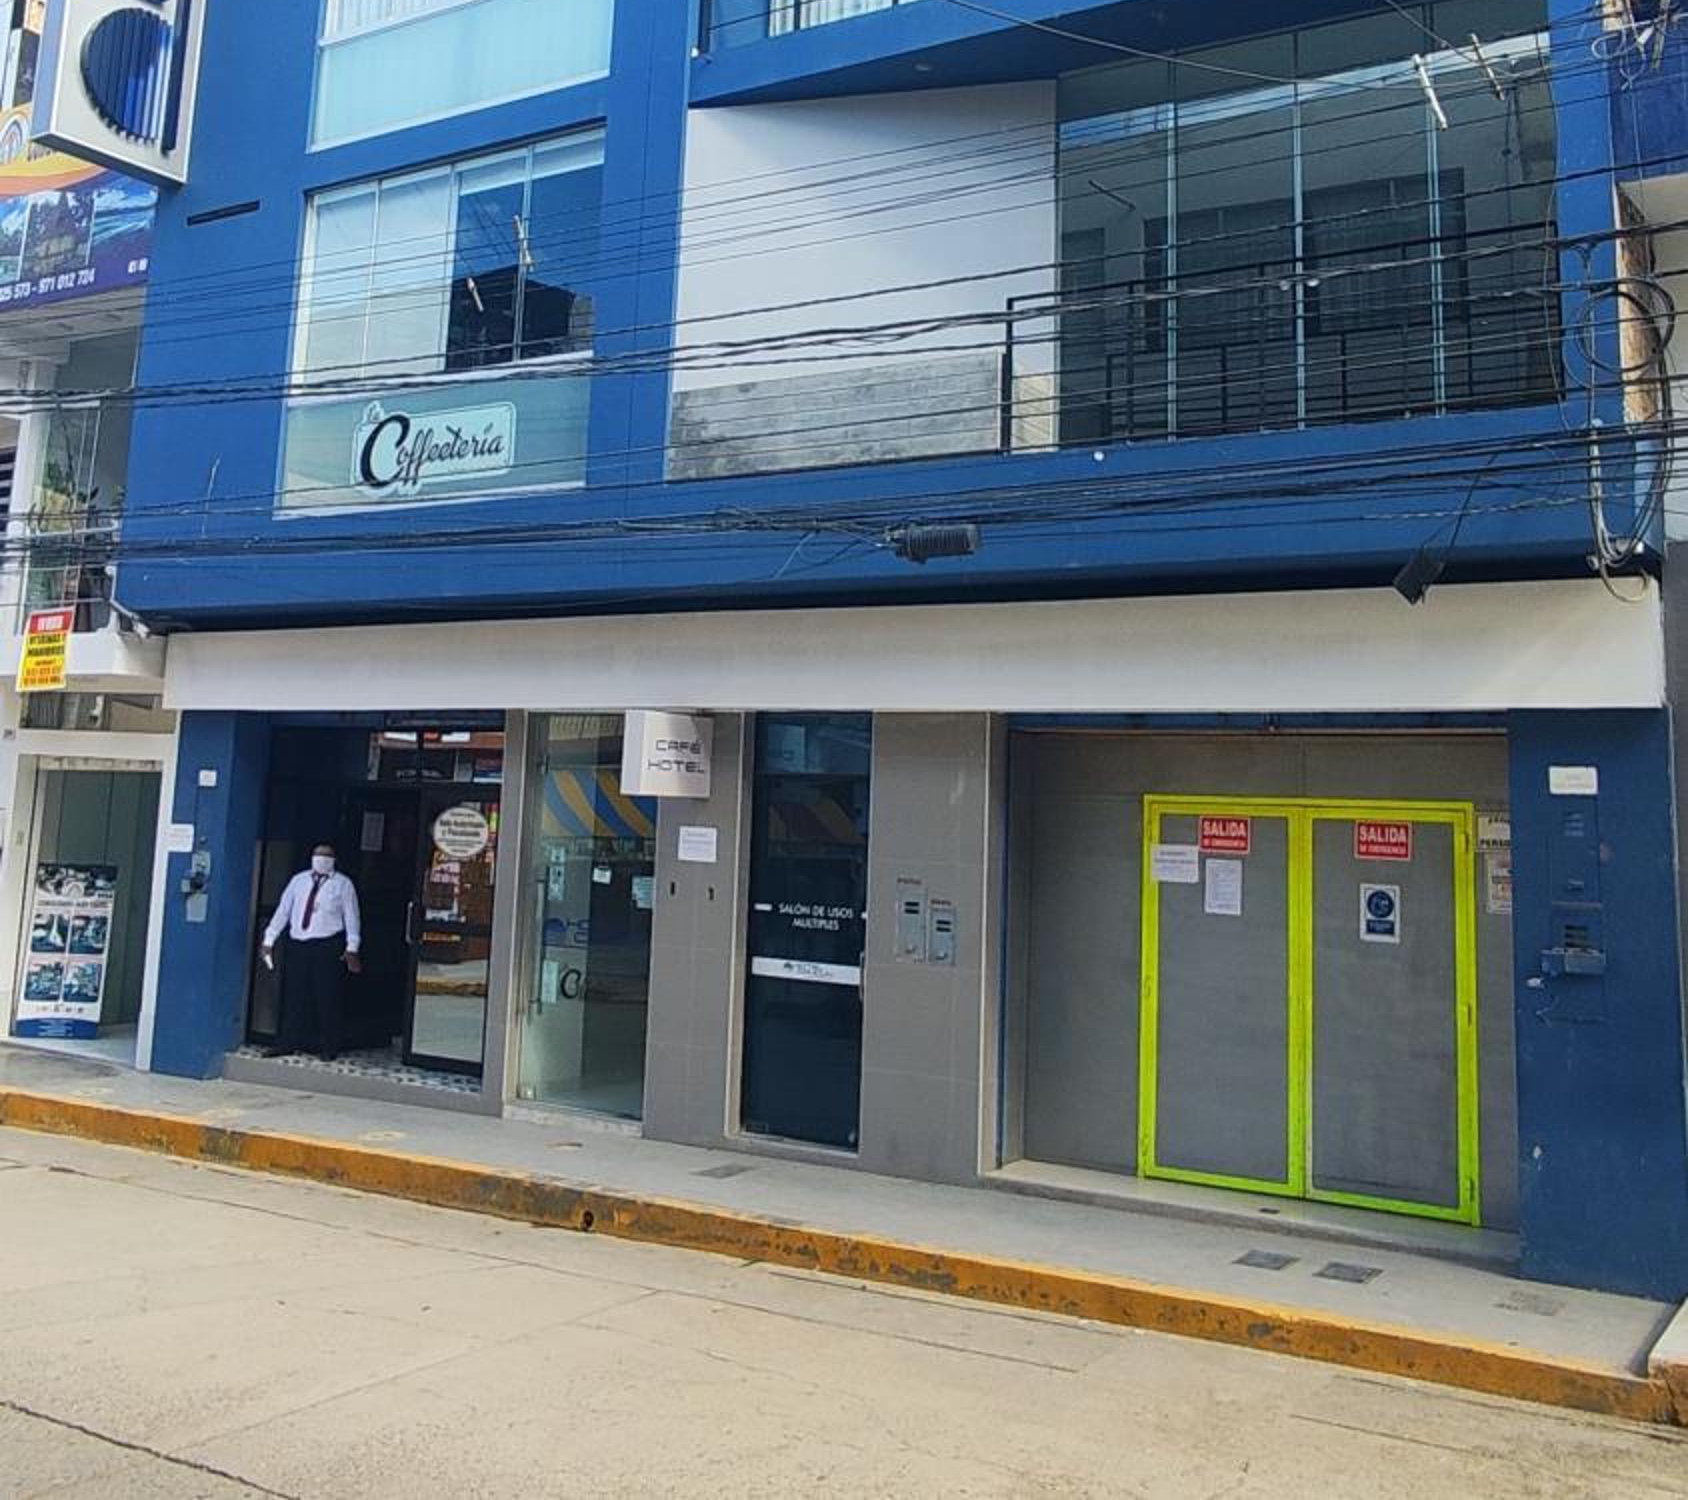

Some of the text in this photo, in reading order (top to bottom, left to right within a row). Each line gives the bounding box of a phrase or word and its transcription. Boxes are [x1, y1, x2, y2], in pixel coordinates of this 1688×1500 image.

[360, 414, 504, 487] Coffeetería
[655, 739, 702, 755] CAFÉ
[647, 759, 705, 775] HOTEL
[1203, 820, 1246, 837] SALIDA
[1359, 825, 1407, 844] SALIDA
[778, 902, 854, 919] SALÓN DE USOS
